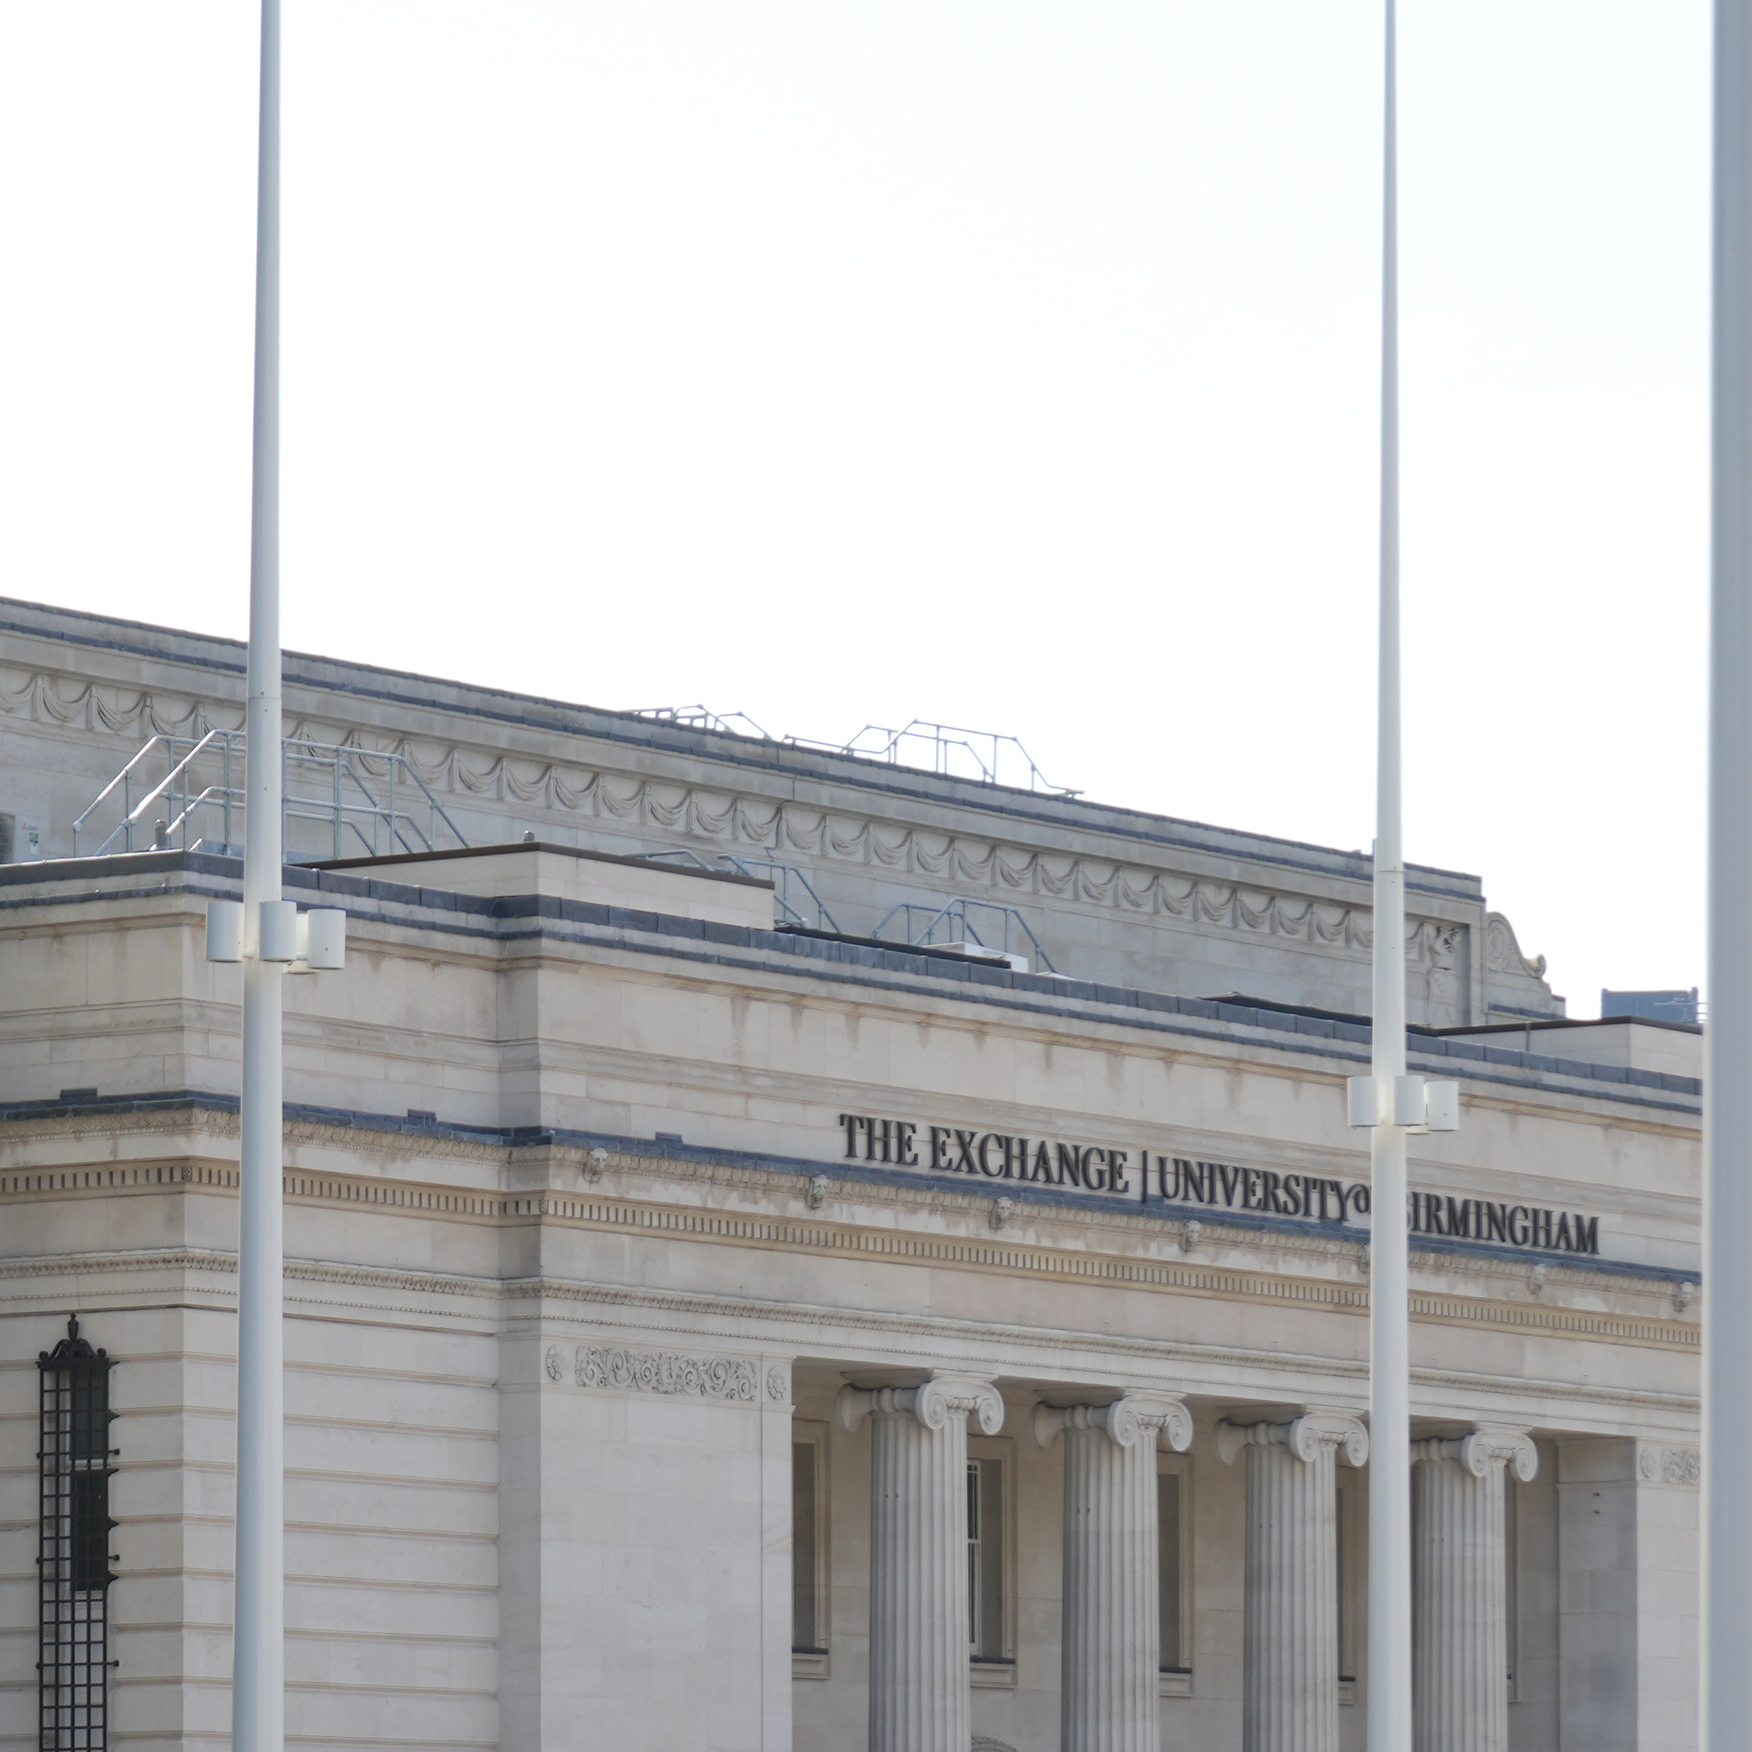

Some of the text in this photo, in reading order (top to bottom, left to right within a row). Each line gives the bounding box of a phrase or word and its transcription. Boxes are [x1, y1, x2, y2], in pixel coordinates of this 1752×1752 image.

[839, 1113, 919, 1166] THE
[929, 1125, 1130, 1193] EXCHANGE
[1157, 1155, 1349, 1222] UNIVERSITY
[1406, 1191, 1601, 1256] IRMINGHAM
